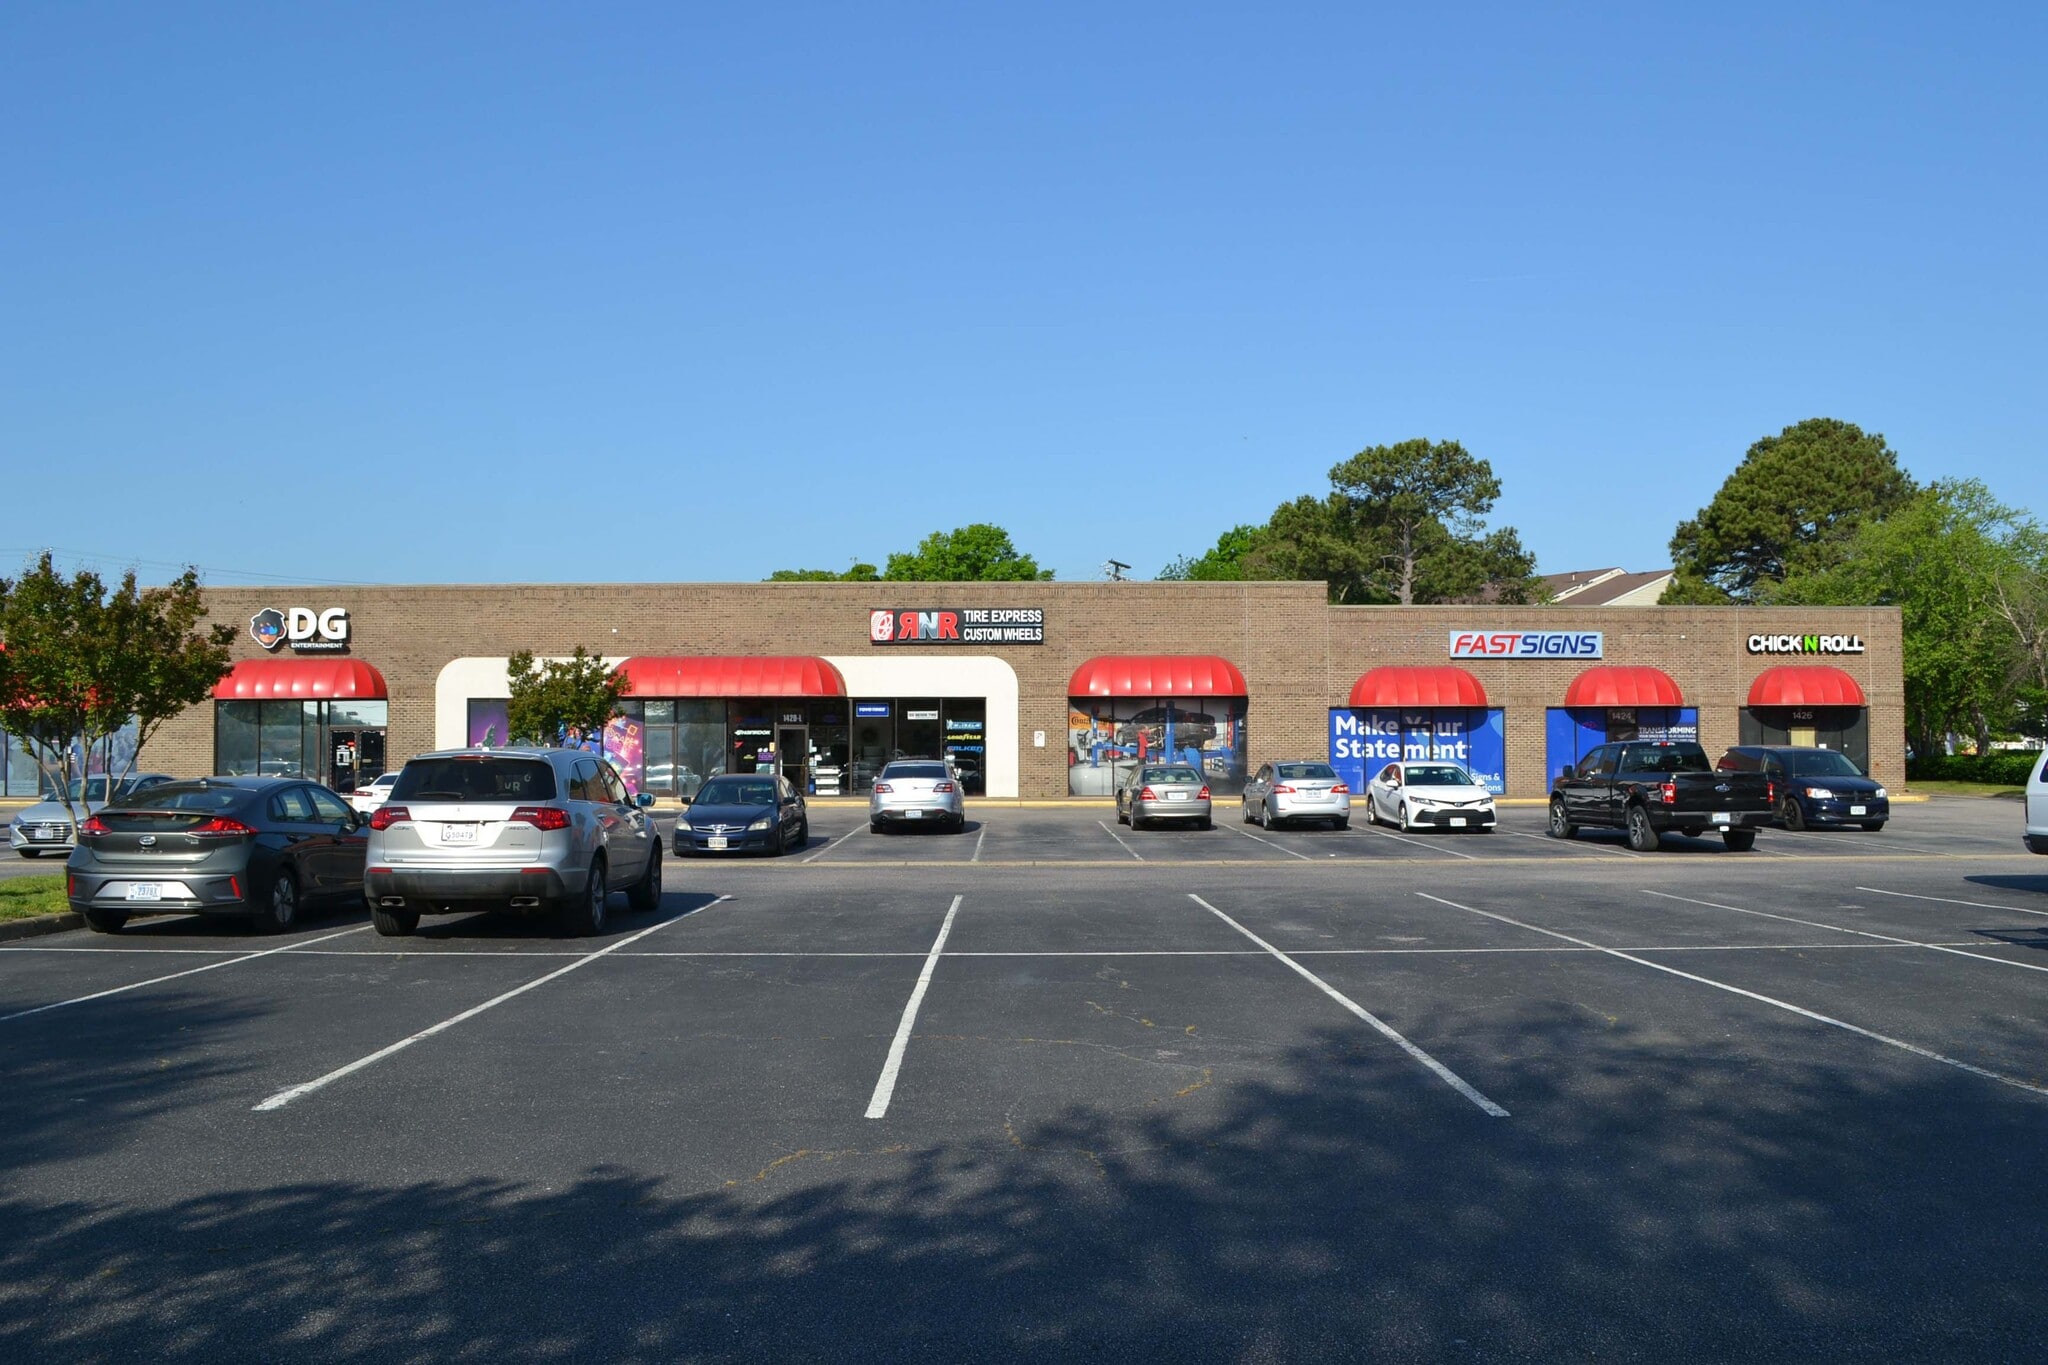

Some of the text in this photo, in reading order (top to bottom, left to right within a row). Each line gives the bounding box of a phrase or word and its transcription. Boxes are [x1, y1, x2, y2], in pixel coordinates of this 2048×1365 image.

[963, 609, 1042, 623] TIRE EXPRESS
[288, 607, 347, 640] DG
[963, 627, 1042, 641] CUSTOM WHEELS
[1454, 634, 1597, 654] FASTSIGNS
[1748, 635, 1865, 652] CHICK N ROLL
[1612, 712, 1632, 720] 1424
[1792, 712, 1813, 720] 1426
[1335, 715, 1463, 737] Make Your
[947, 733, 982, 741] GOODYEAR
[1335, 738, 1467, 759] Statement
[1471, 773, 1500, 781] Signs &
